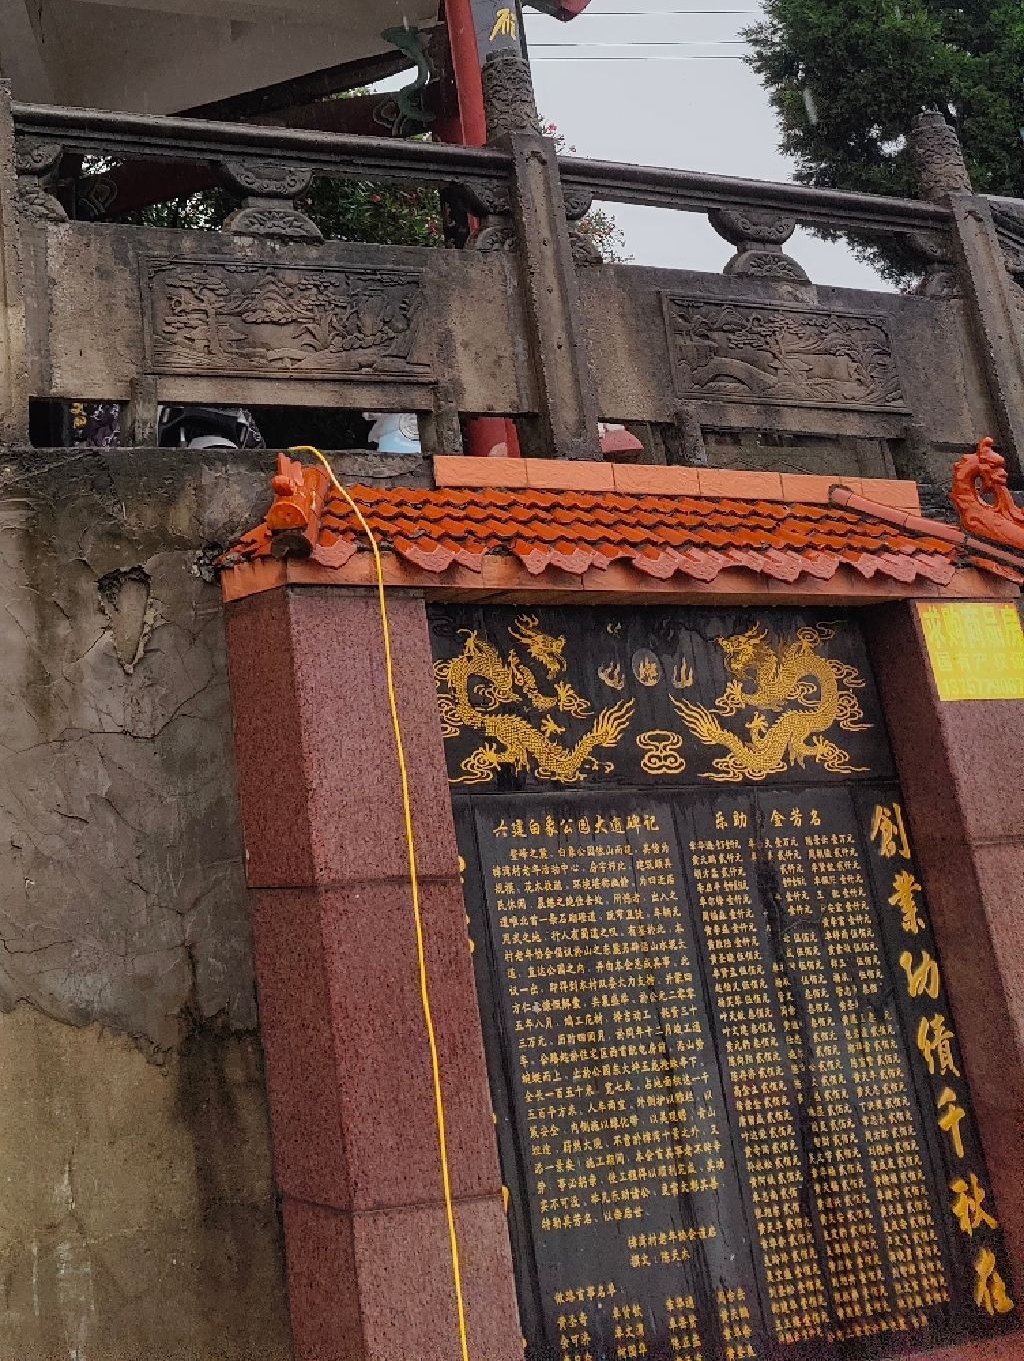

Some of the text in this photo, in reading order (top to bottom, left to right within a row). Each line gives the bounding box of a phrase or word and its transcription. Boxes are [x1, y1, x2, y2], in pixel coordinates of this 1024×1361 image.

[714, 808, 822, 831] 乐助金芳名
